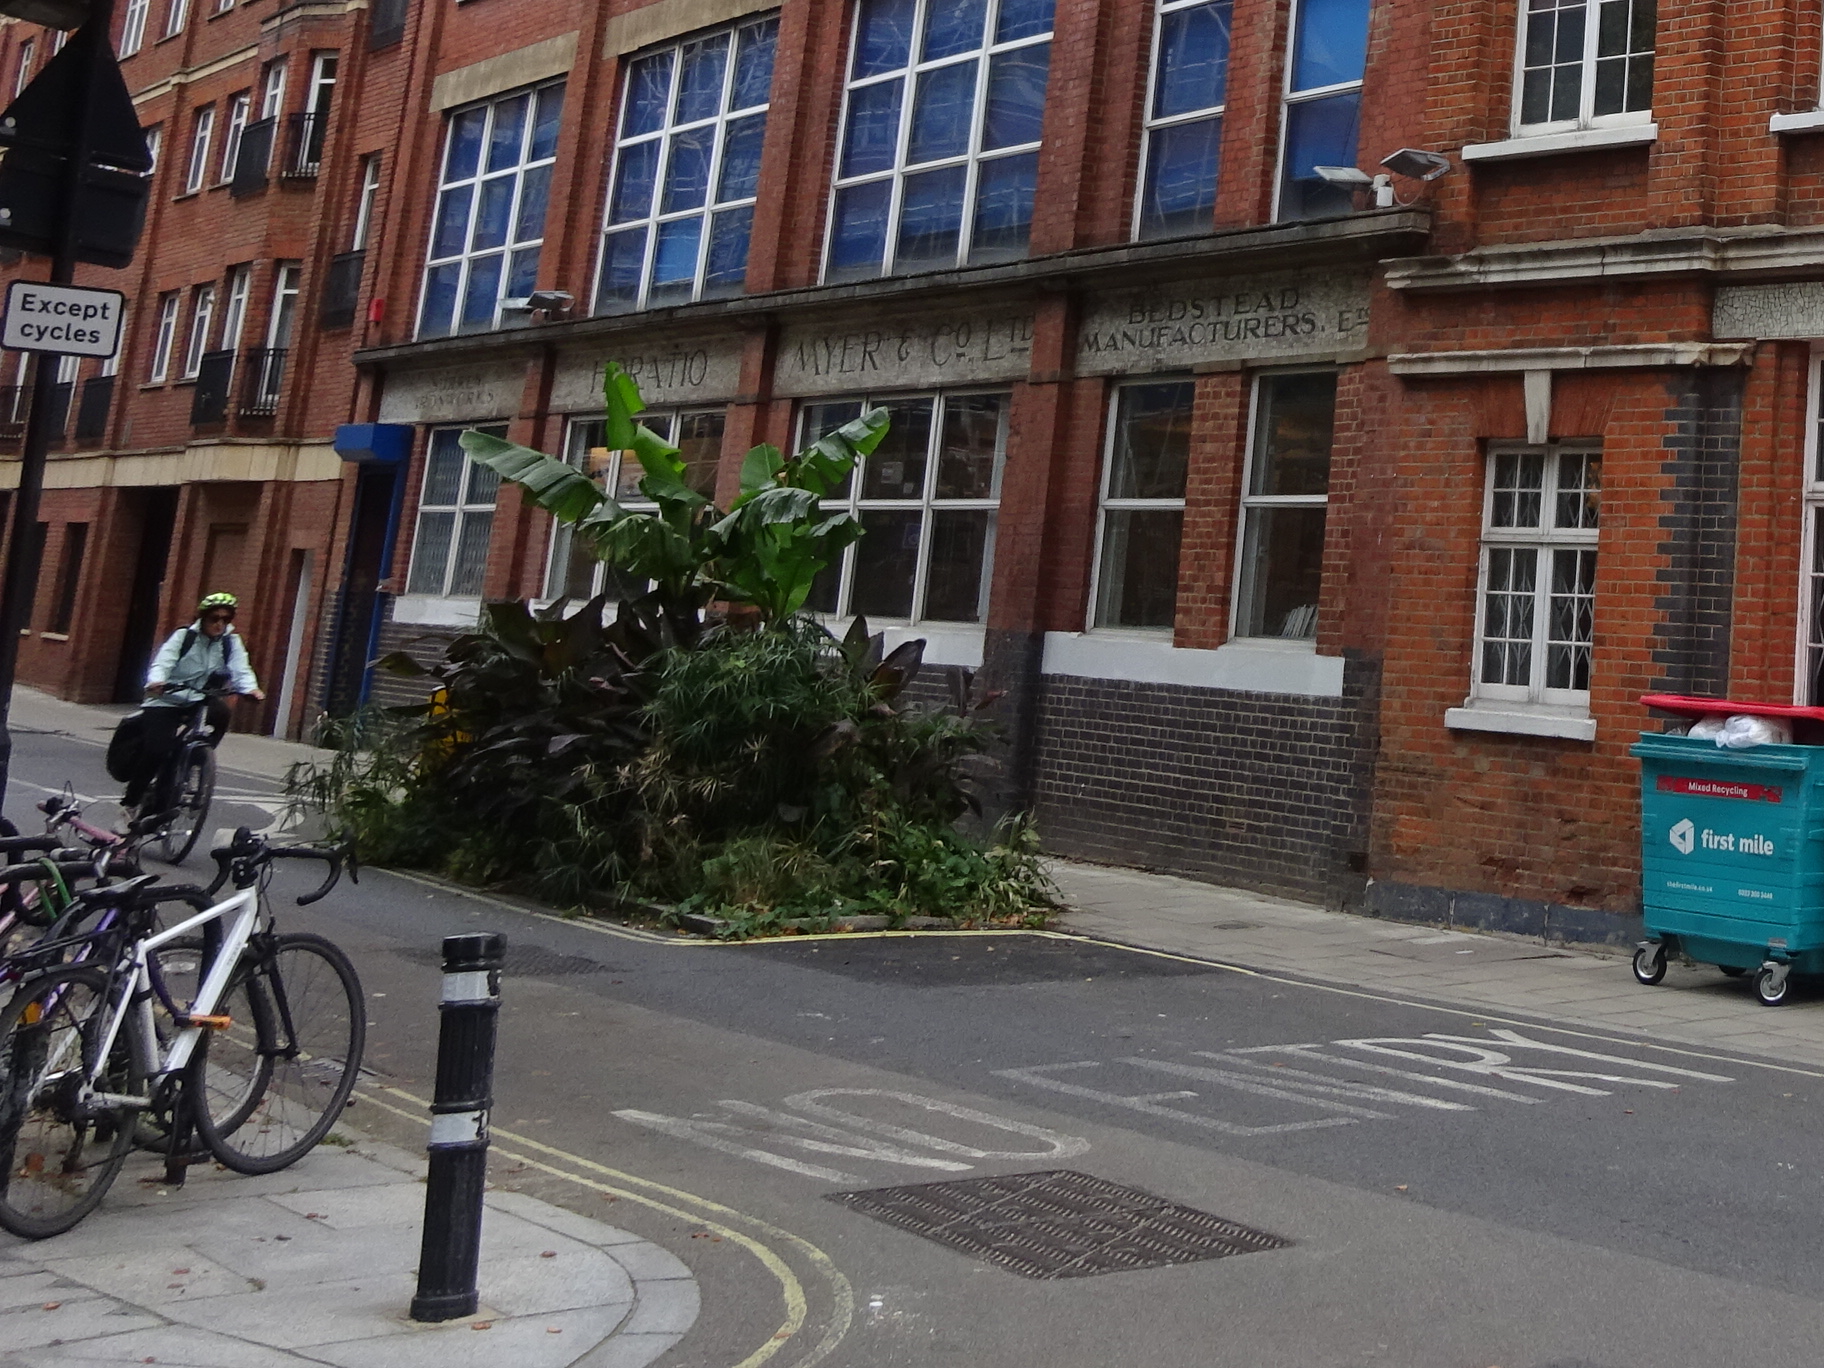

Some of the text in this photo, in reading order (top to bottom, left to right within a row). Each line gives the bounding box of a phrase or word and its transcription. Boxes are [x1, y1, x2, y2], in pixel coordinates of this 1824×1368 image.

[20, 292, 111, 322] Except
[1127, 287, 1300, 326] BEDSTEAD
[20, 322, 101, 345] cycles
[788, 330, 883, 377] MYER
[1688, 781, 1748, 798] Mixed Recycling
[1701, 828, 1774, 855] first mile
[609, 1028, 1737, 1184] NO ENTRY
